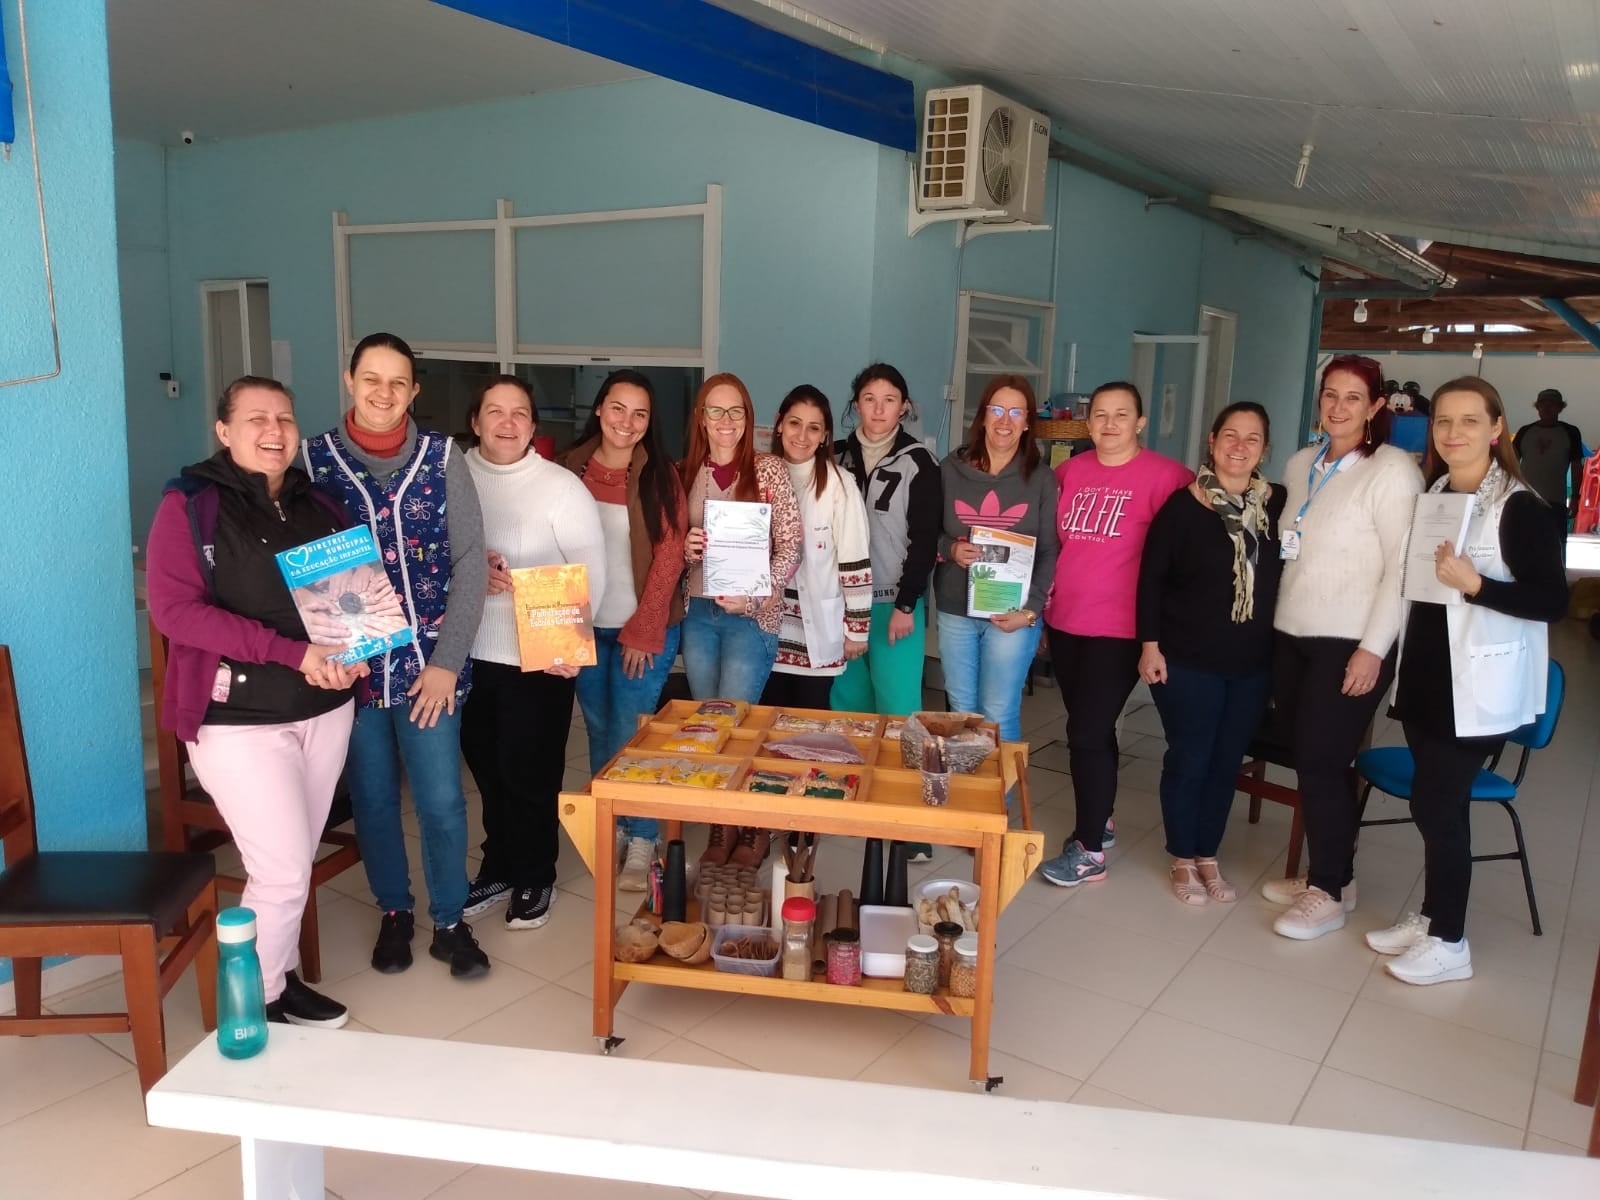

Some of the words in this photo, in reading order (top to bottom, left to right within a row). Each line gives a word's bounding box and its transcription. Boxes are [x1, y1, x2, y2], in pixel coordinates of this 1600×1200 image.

[874, 468, 902, 512] 7
[1112, 489, 1133, 497] HAVE
[1061, 492, 1132, 538] SELFIE
[307, 535, 347, 554] DIRETRIZ
[326, 536, 370, 555] MUNICIPAL
[873, 588, 895, 598] OUNG
